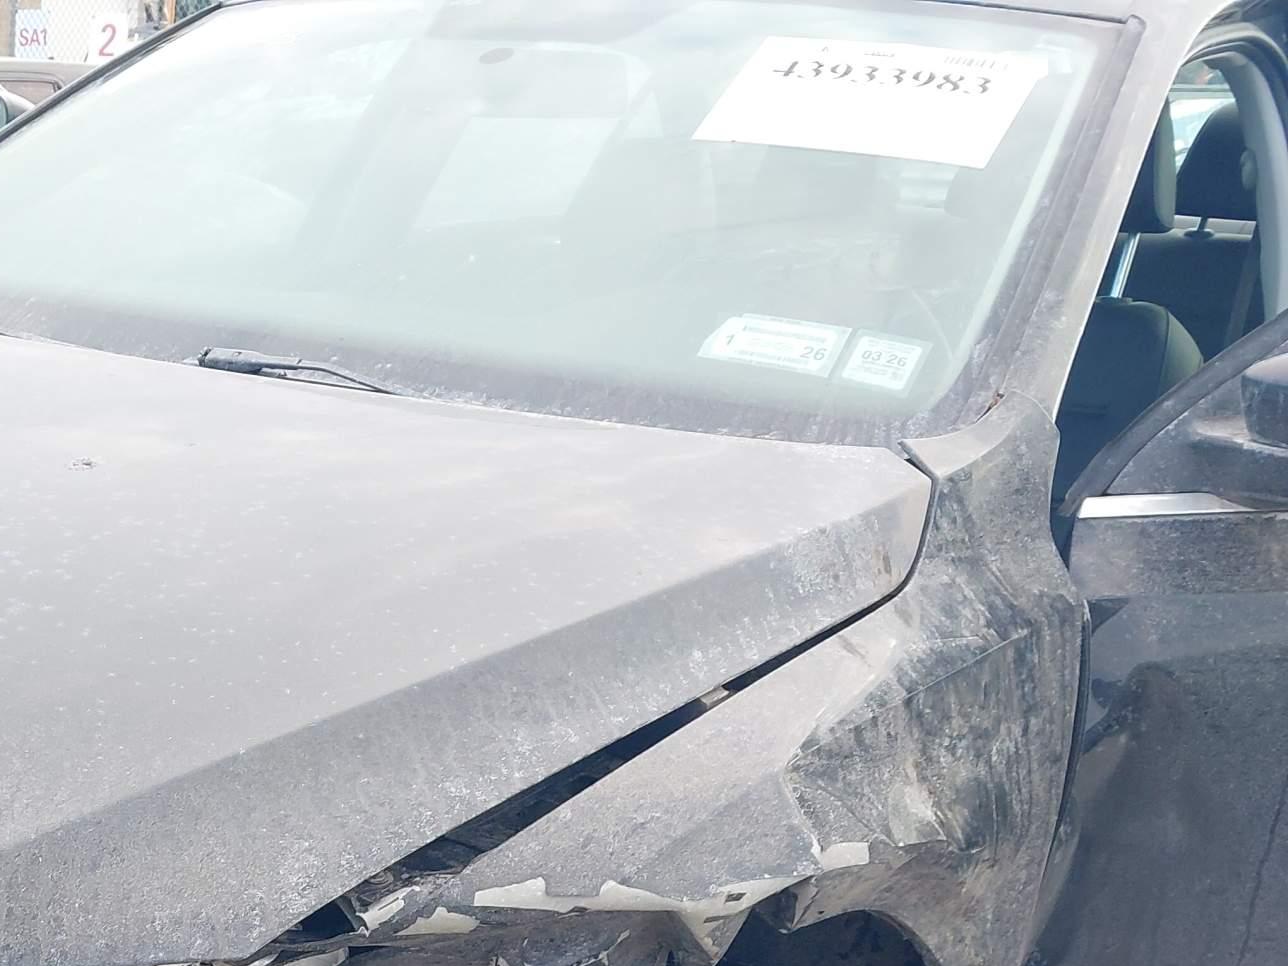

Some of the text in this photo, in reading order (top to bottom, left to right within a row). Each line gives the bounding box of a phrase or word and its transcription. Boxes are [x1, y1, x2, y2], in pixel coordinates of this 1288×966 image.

[98, 23, 118, 57] 2
[772, 59, 993, 94] 43933983
[800, 345, 828, 361] 26
[886, 353, 908, 368] 26
